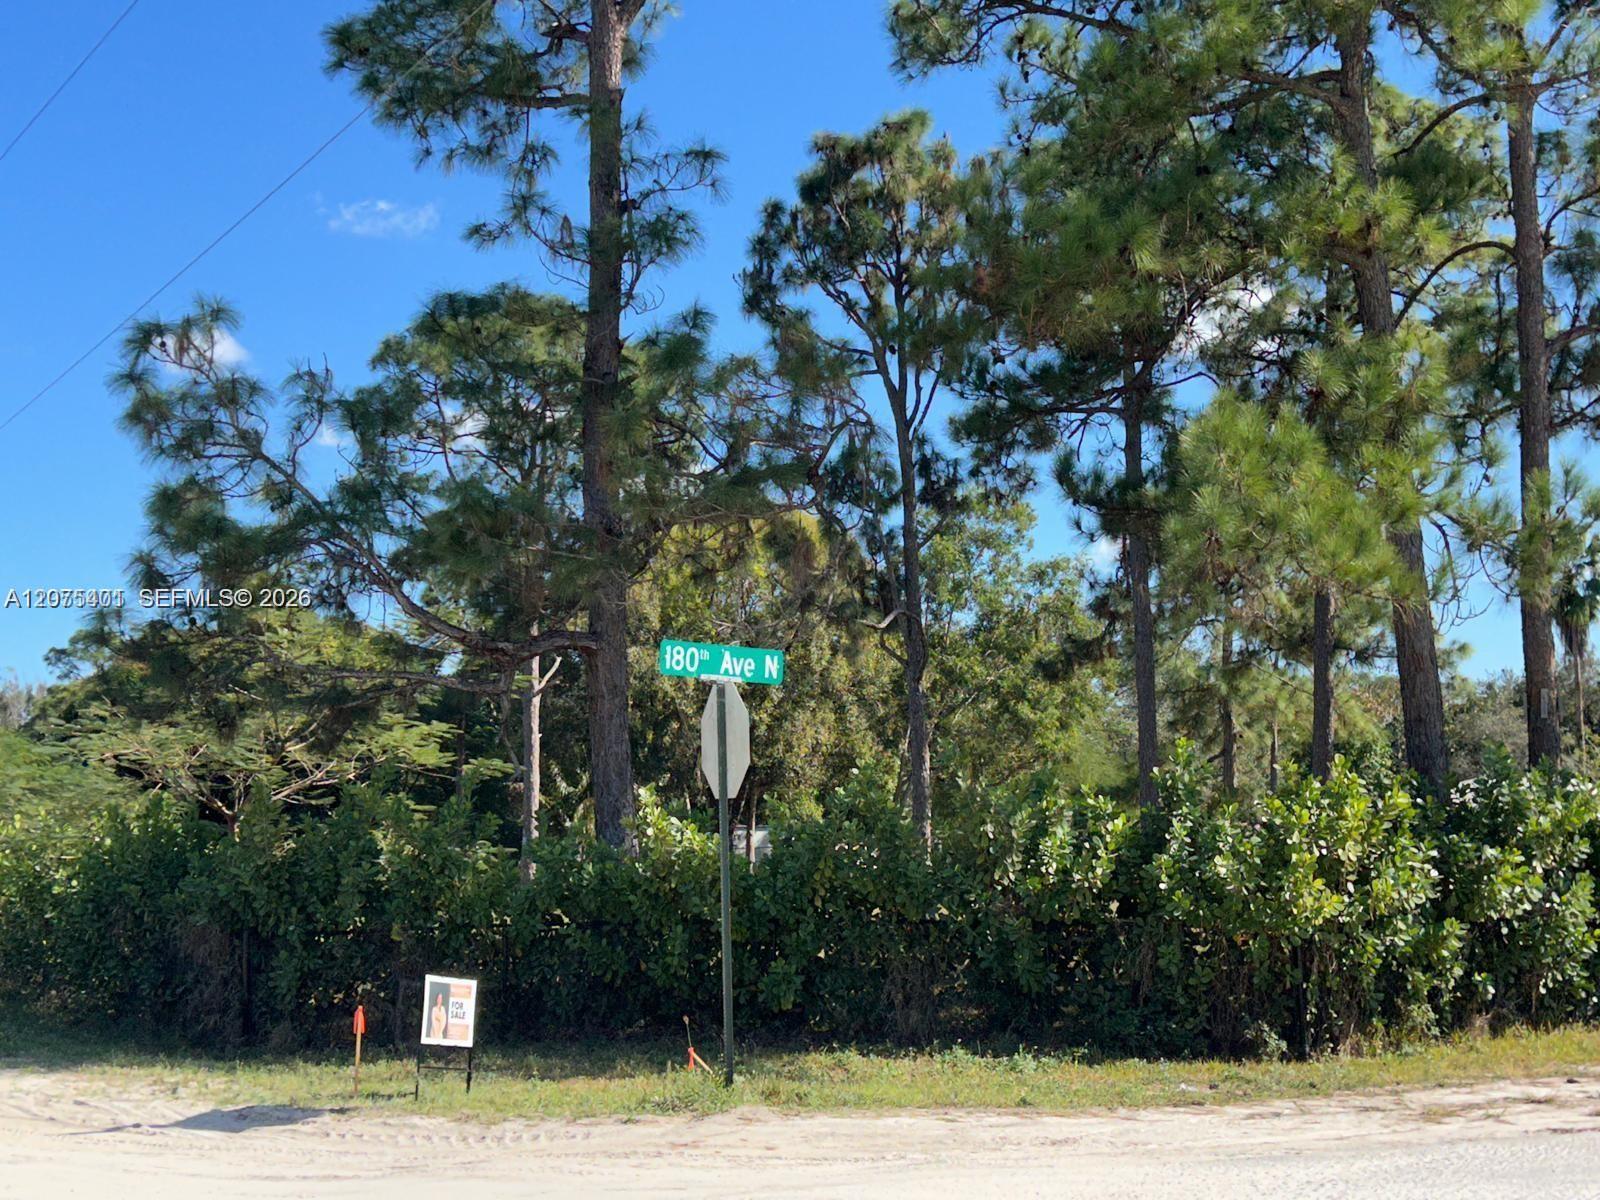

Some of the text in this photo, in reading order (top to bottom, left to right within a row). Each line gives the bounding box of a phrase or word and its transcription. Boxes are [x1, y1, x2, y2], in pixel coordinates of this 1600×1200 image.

[664, 645, 779, 679] 180th Ave N
[451, 1001, 464, 1010] FOR
[450, 1010, 466, 1019] SALE
